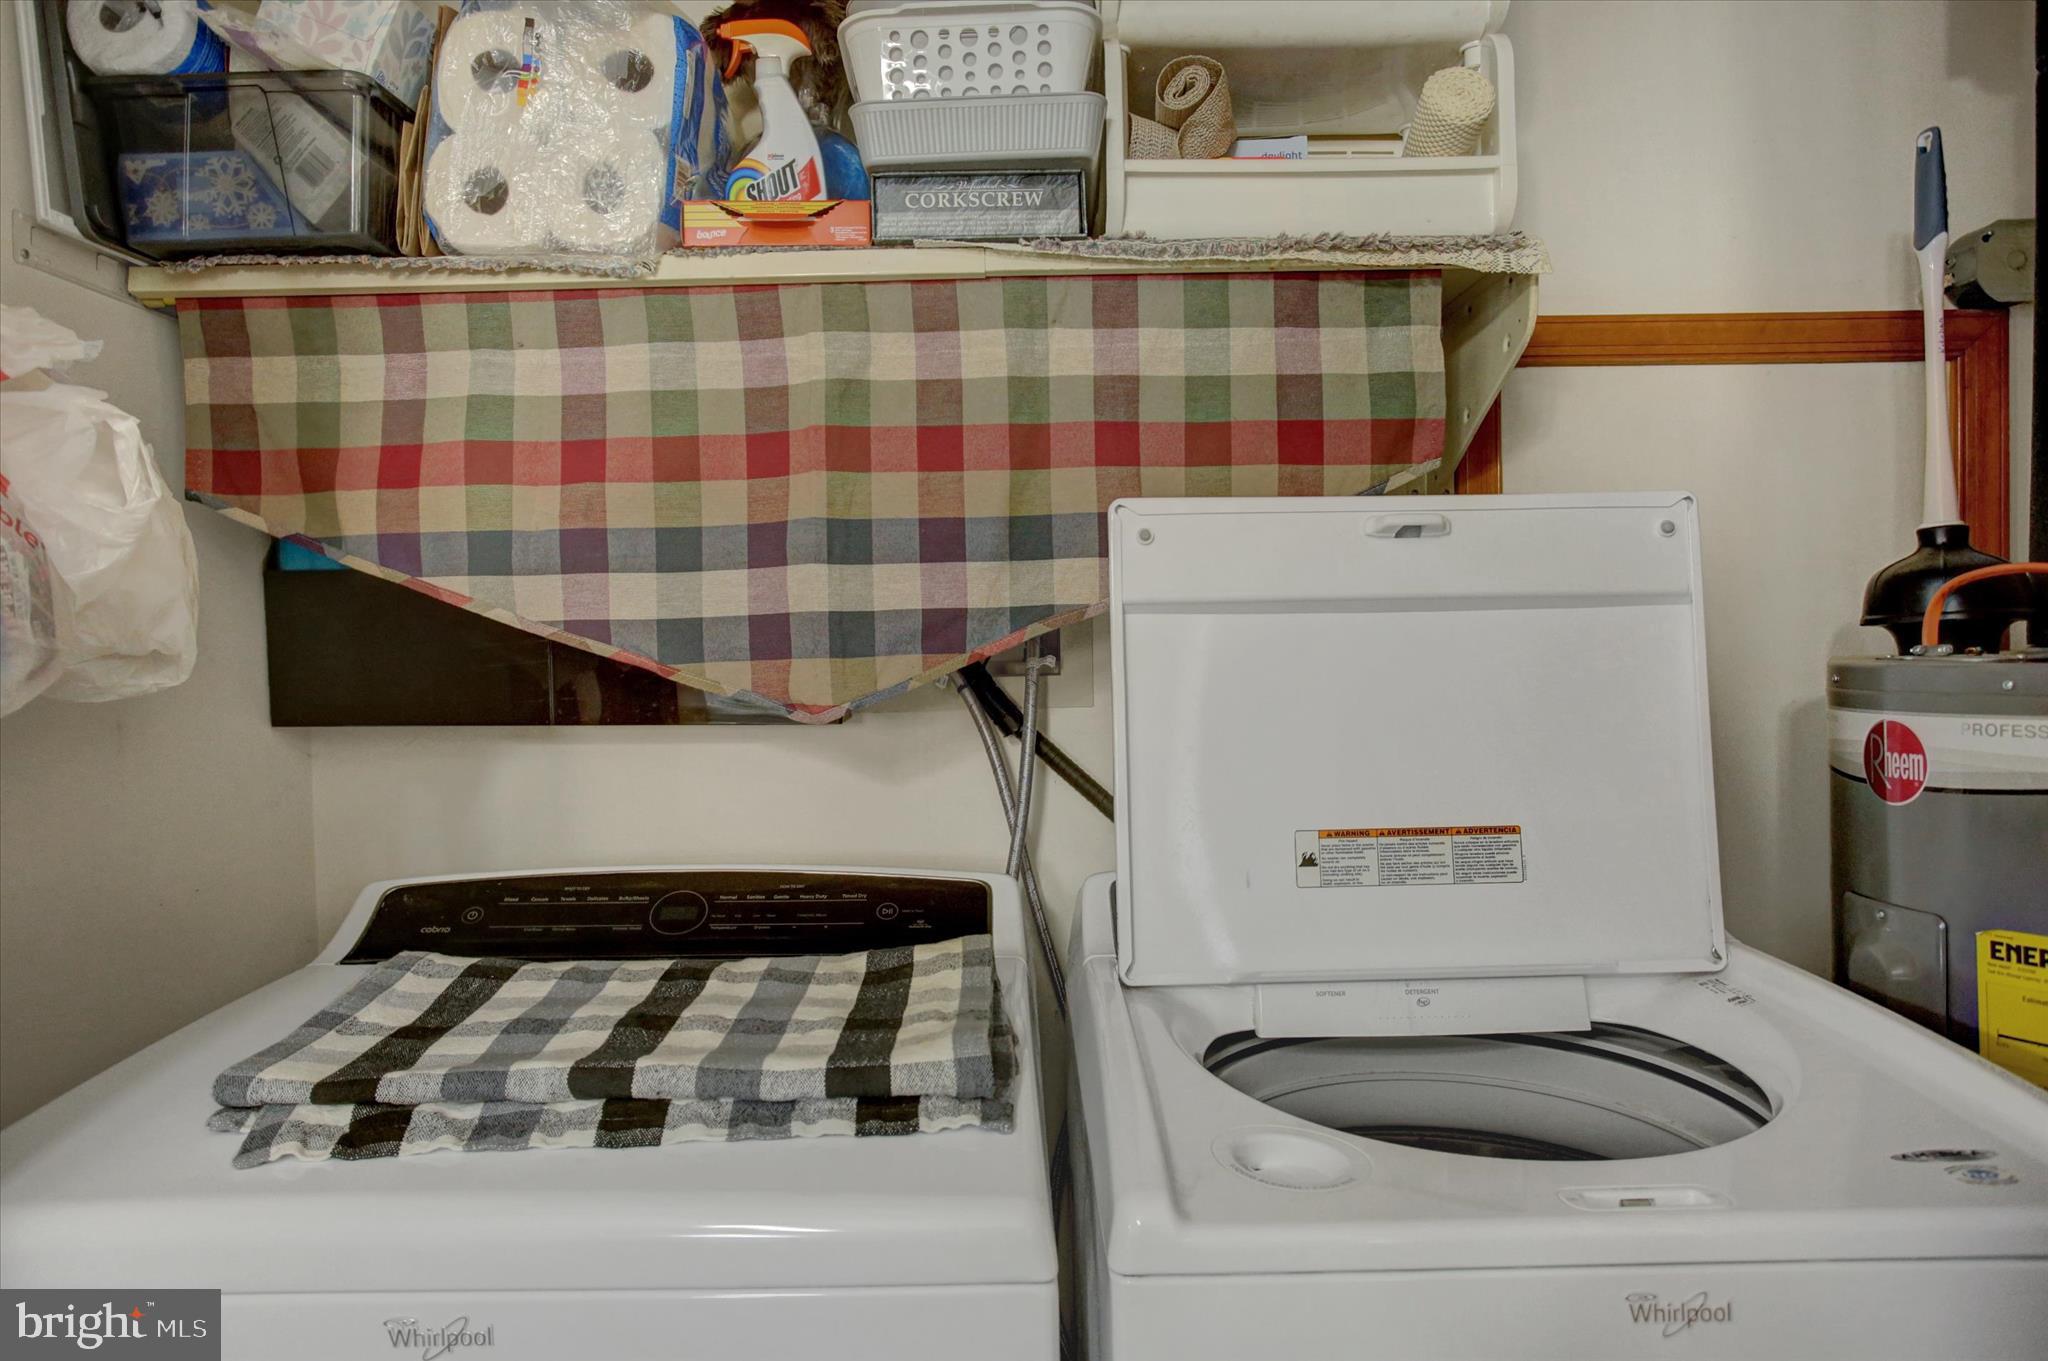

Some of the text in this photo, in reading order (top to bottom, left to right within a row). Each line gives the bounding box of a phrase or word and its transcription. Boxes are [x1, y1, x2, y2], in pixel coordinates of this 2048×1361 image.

[746, 158, 798, 201] SHOUT
[904, 191, 1044, 209] CORKSCREW
[696, 229, 727, 239] bounce
[1961, 722, 2048, 739] PROFESS
[1869, 719, 1924, 789] Rheem
[1387, 828, 1449, 836] AVERTISSEMENT
[1463, 826, 1517, 834] ADVERTENCIA
[1627, 1301, 1733, 1329] Whirlpool
[386, 1325, 495, 1353] Whirlpool
